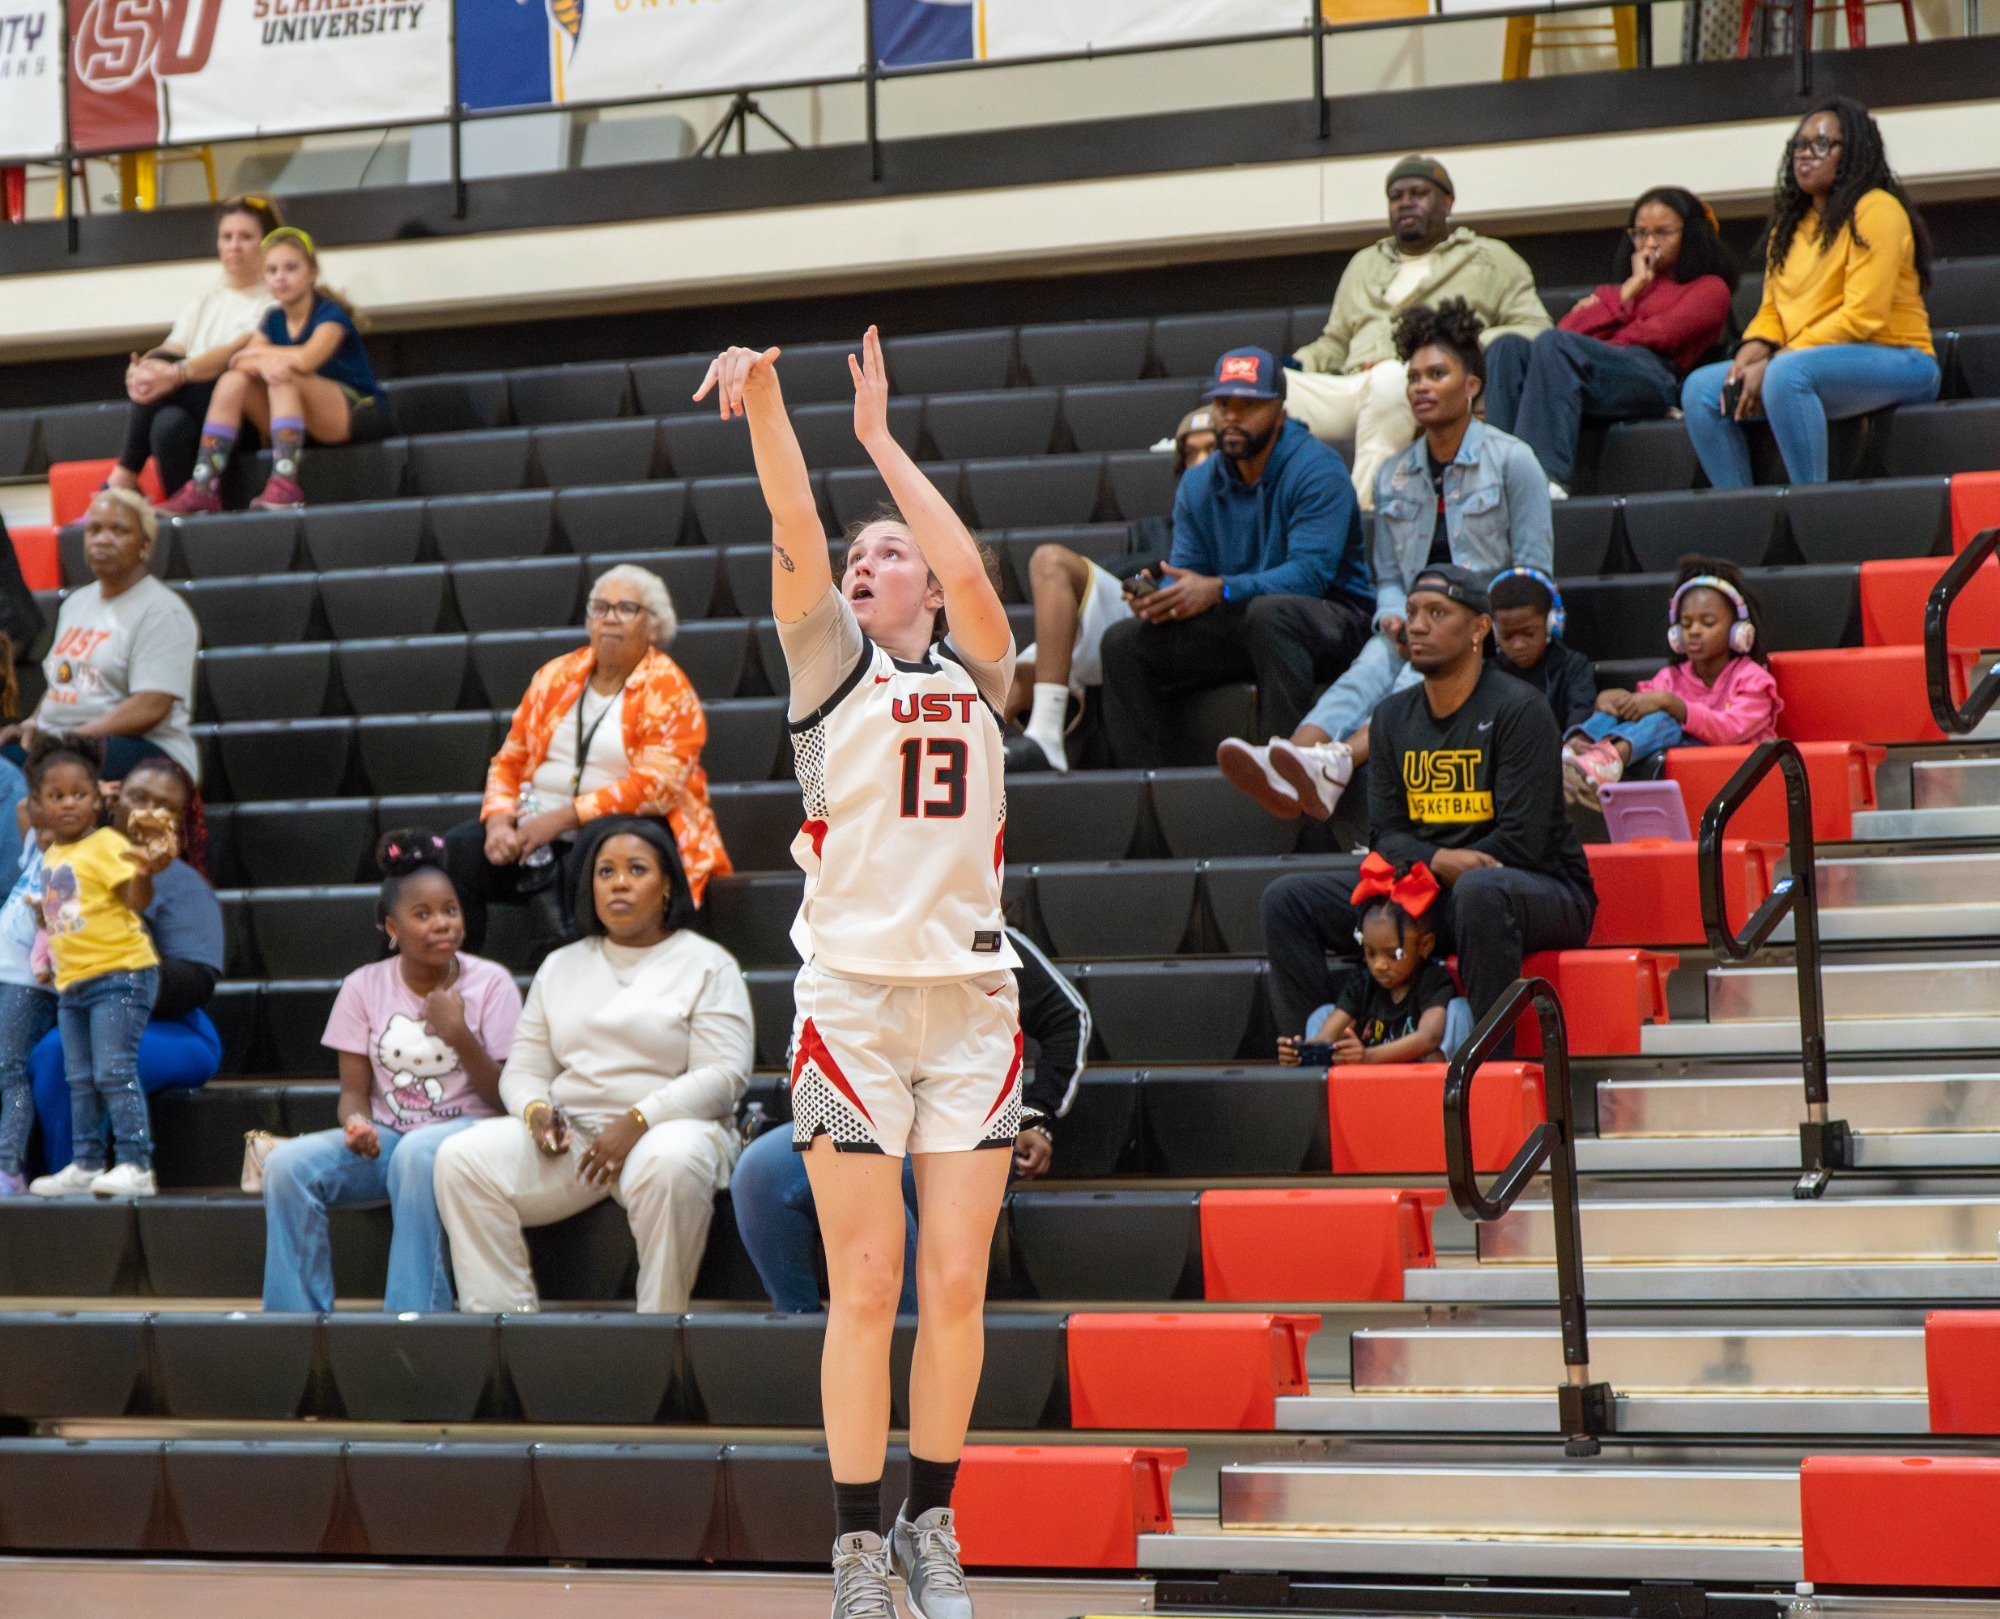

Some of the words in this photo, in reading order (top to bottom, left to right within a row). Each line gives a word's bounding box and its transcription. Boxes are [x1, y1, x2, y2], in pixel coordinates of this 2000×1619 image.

[262, 4, 424, 45] UNIVERSITY
[54, 626, 113, 661] UST
[892, 693, 978, 723] UST
[900, 737, 968, 819] 13
[1403, 749, 1482, 792] UST
[1411, 797, 1490, 815] SKETBALL
